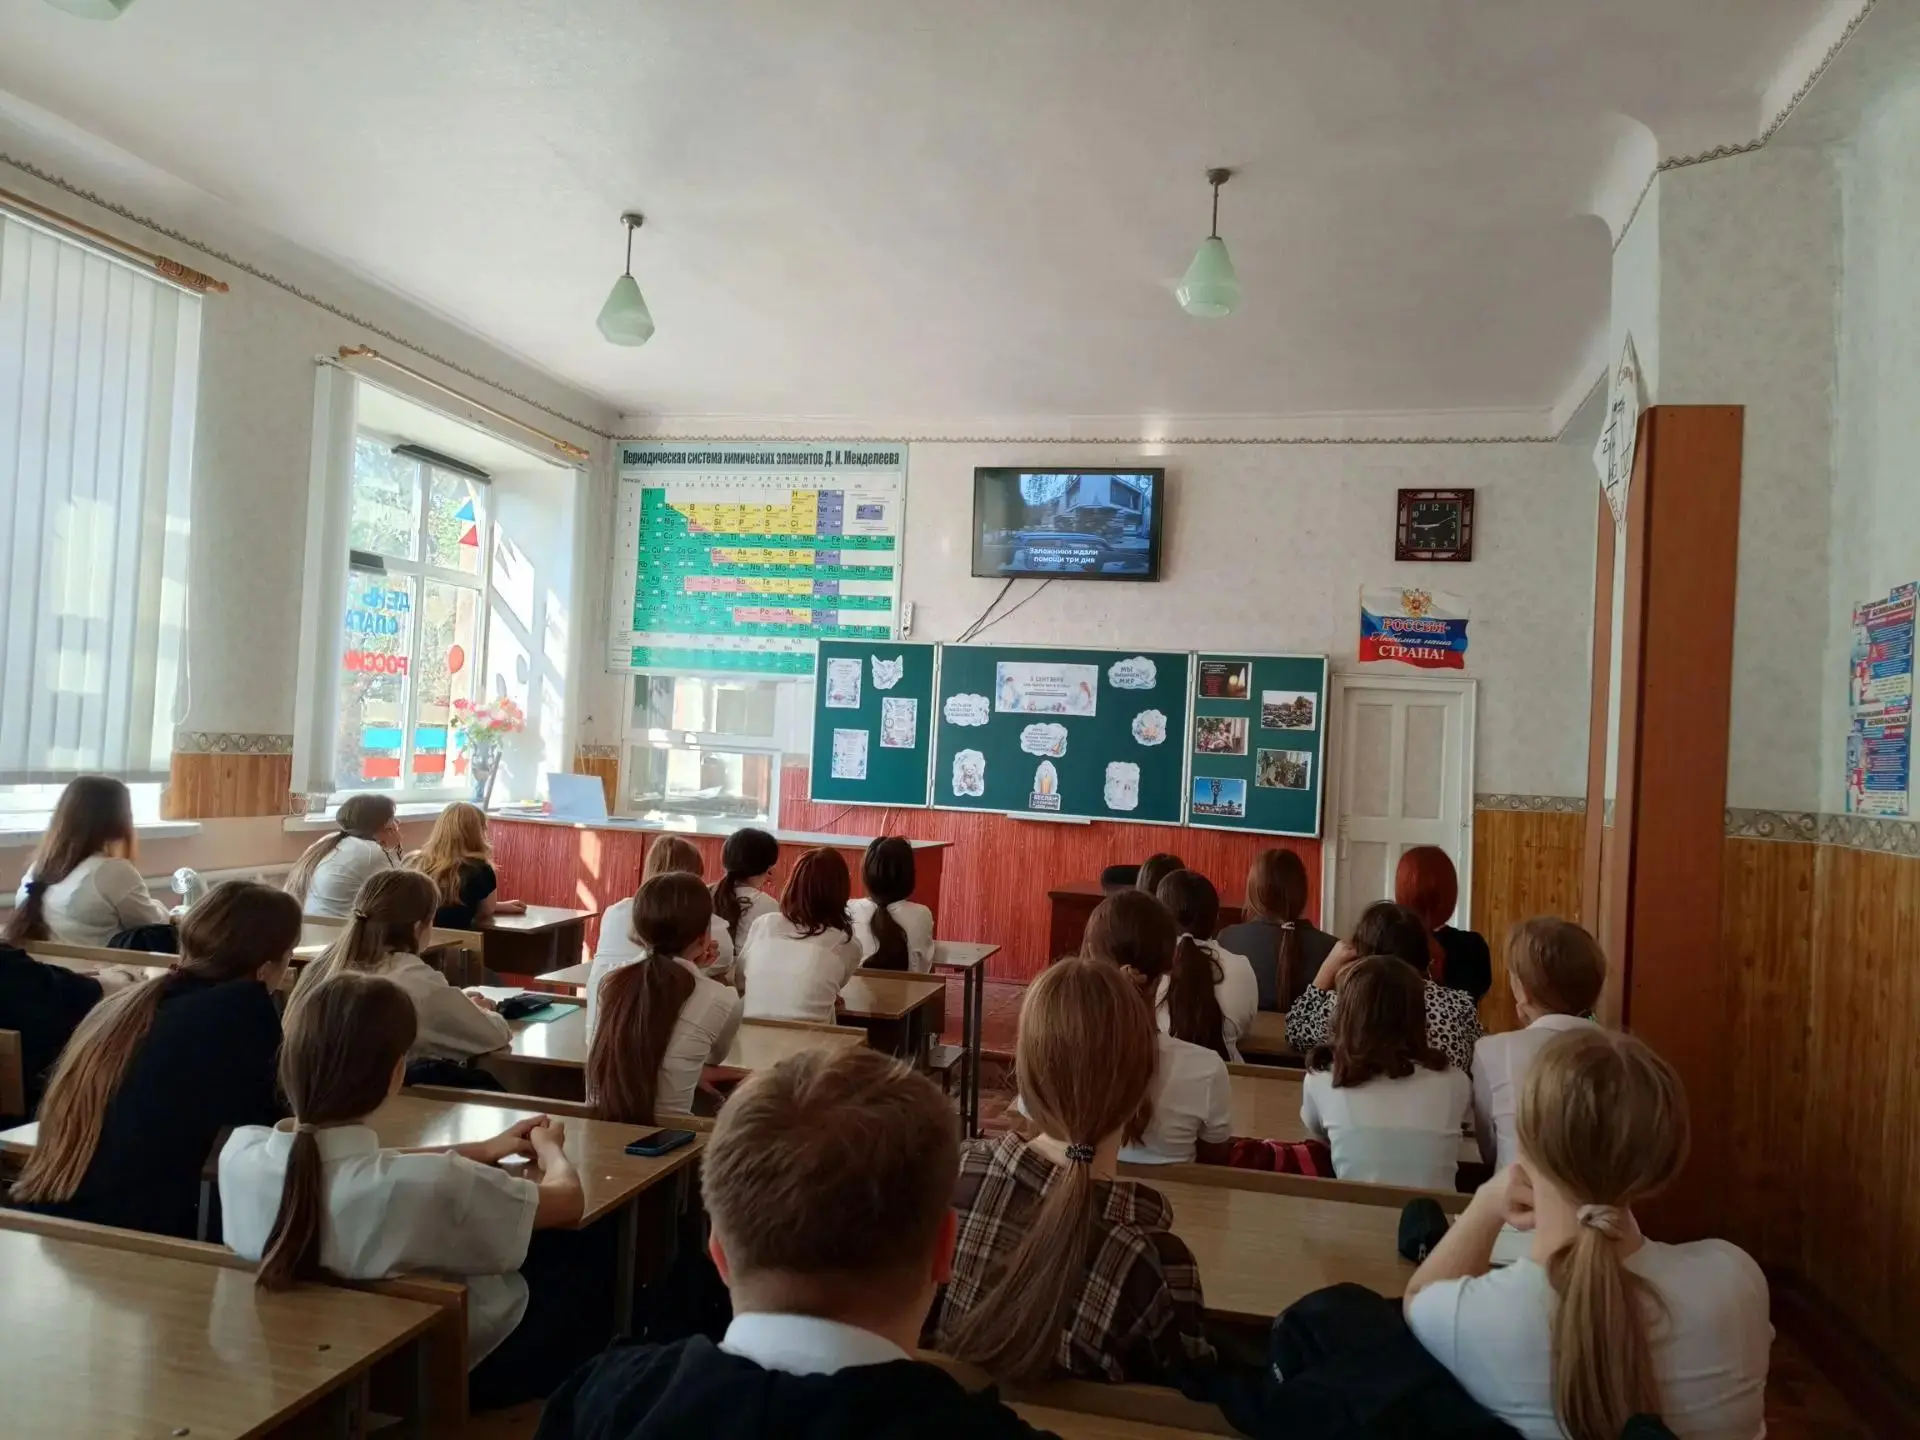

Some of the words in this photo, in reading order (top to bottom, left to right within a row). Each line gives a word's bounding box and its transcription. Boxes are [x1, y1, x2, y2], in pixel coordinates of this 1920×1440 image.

[623, 450, 686, 467] Периодическая
[687, 451, 722, 465] система
[723, 452, 775, 465] химических
[776, 451, 824, 465] элементов
[824, 450, 833, 467] Д.
[835, 450, 843, 465] И.
[843, 450, 900, 467] Менделеева
[1419, 503, 1426, 511] 11
[1431, 503, 1440, 512] 12
[1029, 547, 1072, 556] Заложники
[1033, 556, 1065, 564] помощи
[1370, 631, 1421, 644] Любимая
[1379, 645, 1445, 660] СТРАНА!
